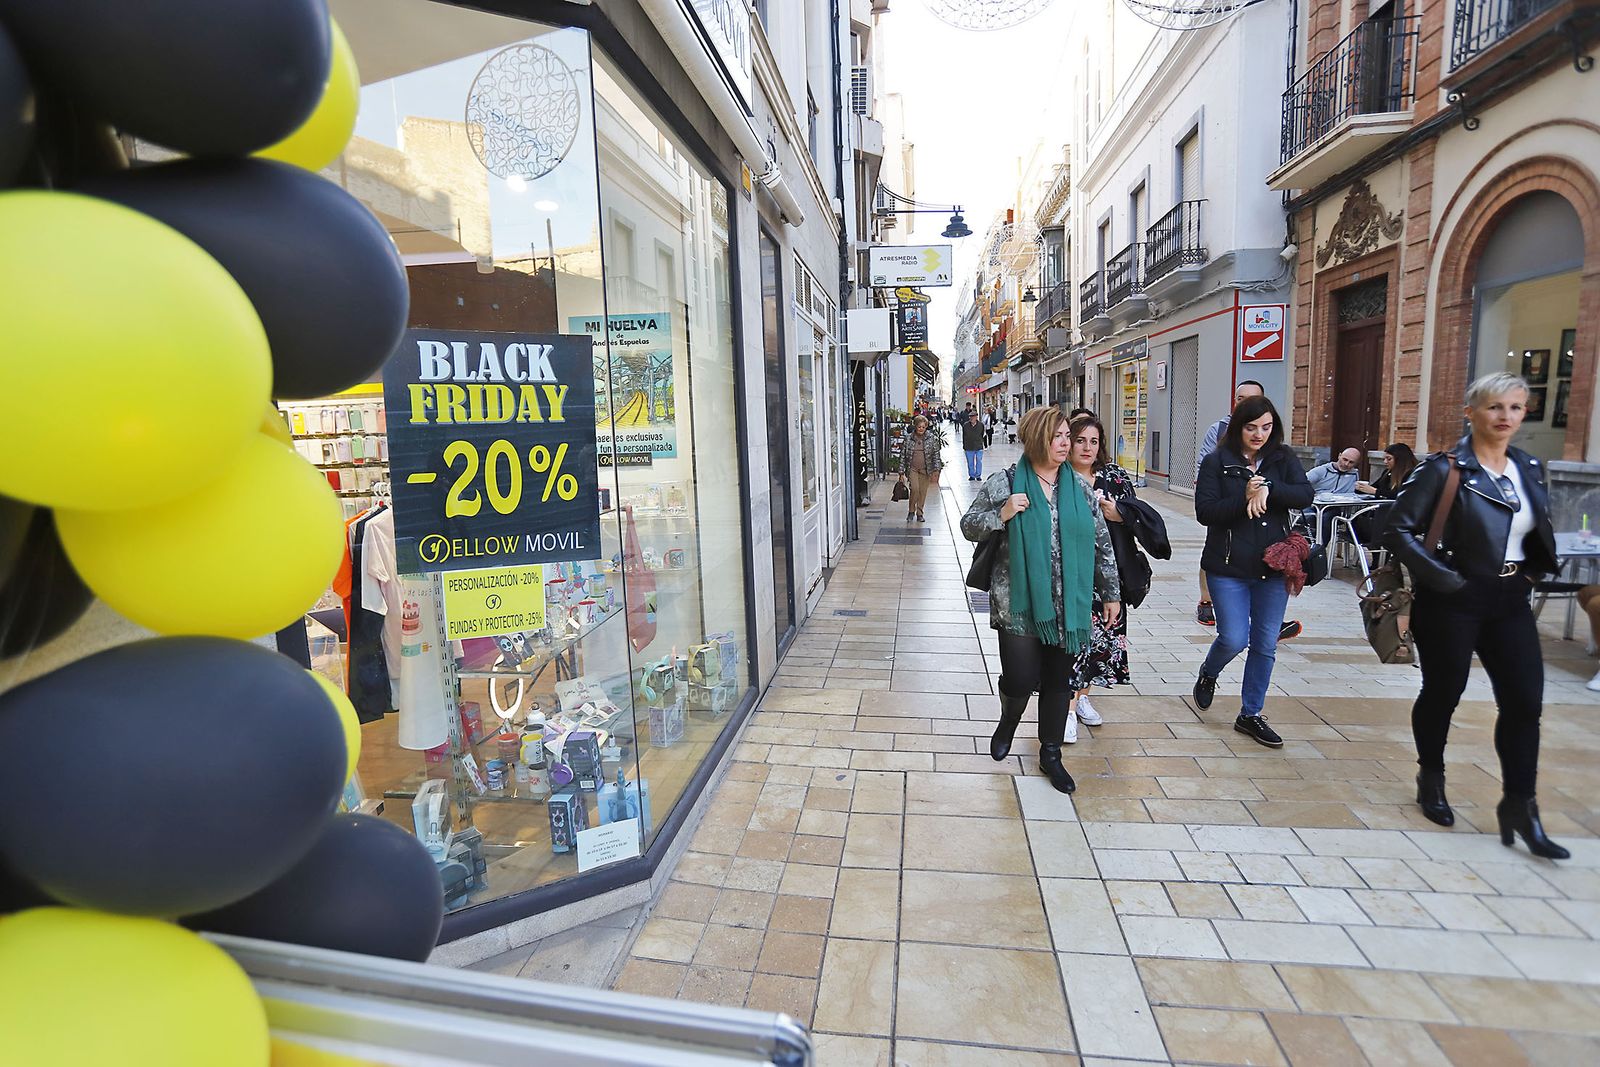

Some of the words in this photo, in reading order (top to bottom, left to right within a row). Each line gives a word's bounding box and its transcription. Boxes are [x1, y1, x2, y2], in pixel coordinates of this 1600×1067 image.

[585, 321, 600, 332] MI
[606, 318, 658, 332] HUELVA
[592, 339, 618, 347] Andés
[620, 338, 650, 347] Espuelas
[416, 340, 559, 383] BLACK
[407, 383, 570, 425] FRIDAY
[626, 432, 664, 442] exclusivas
[858, 401, 867, 463] ZAPATERO
[600, 444, 622, 454] funa
[623, 442, 673, 453] personalizada
[631, 455, 650, 463] MOVIL
[406, 439, 579, 519] -20%
[525, 532, 585, 553] MOVIL
[448, 571, 519, 592] PERSONALIZACIÓN
[520, 572, 540, 585] -20%
[450, 619, 478, 635] FUNDAS
[478, 618, 484, 631] Y
[485, 614, 525, 630] PROTECTOR
[525, 611, 543, 626] -25%
